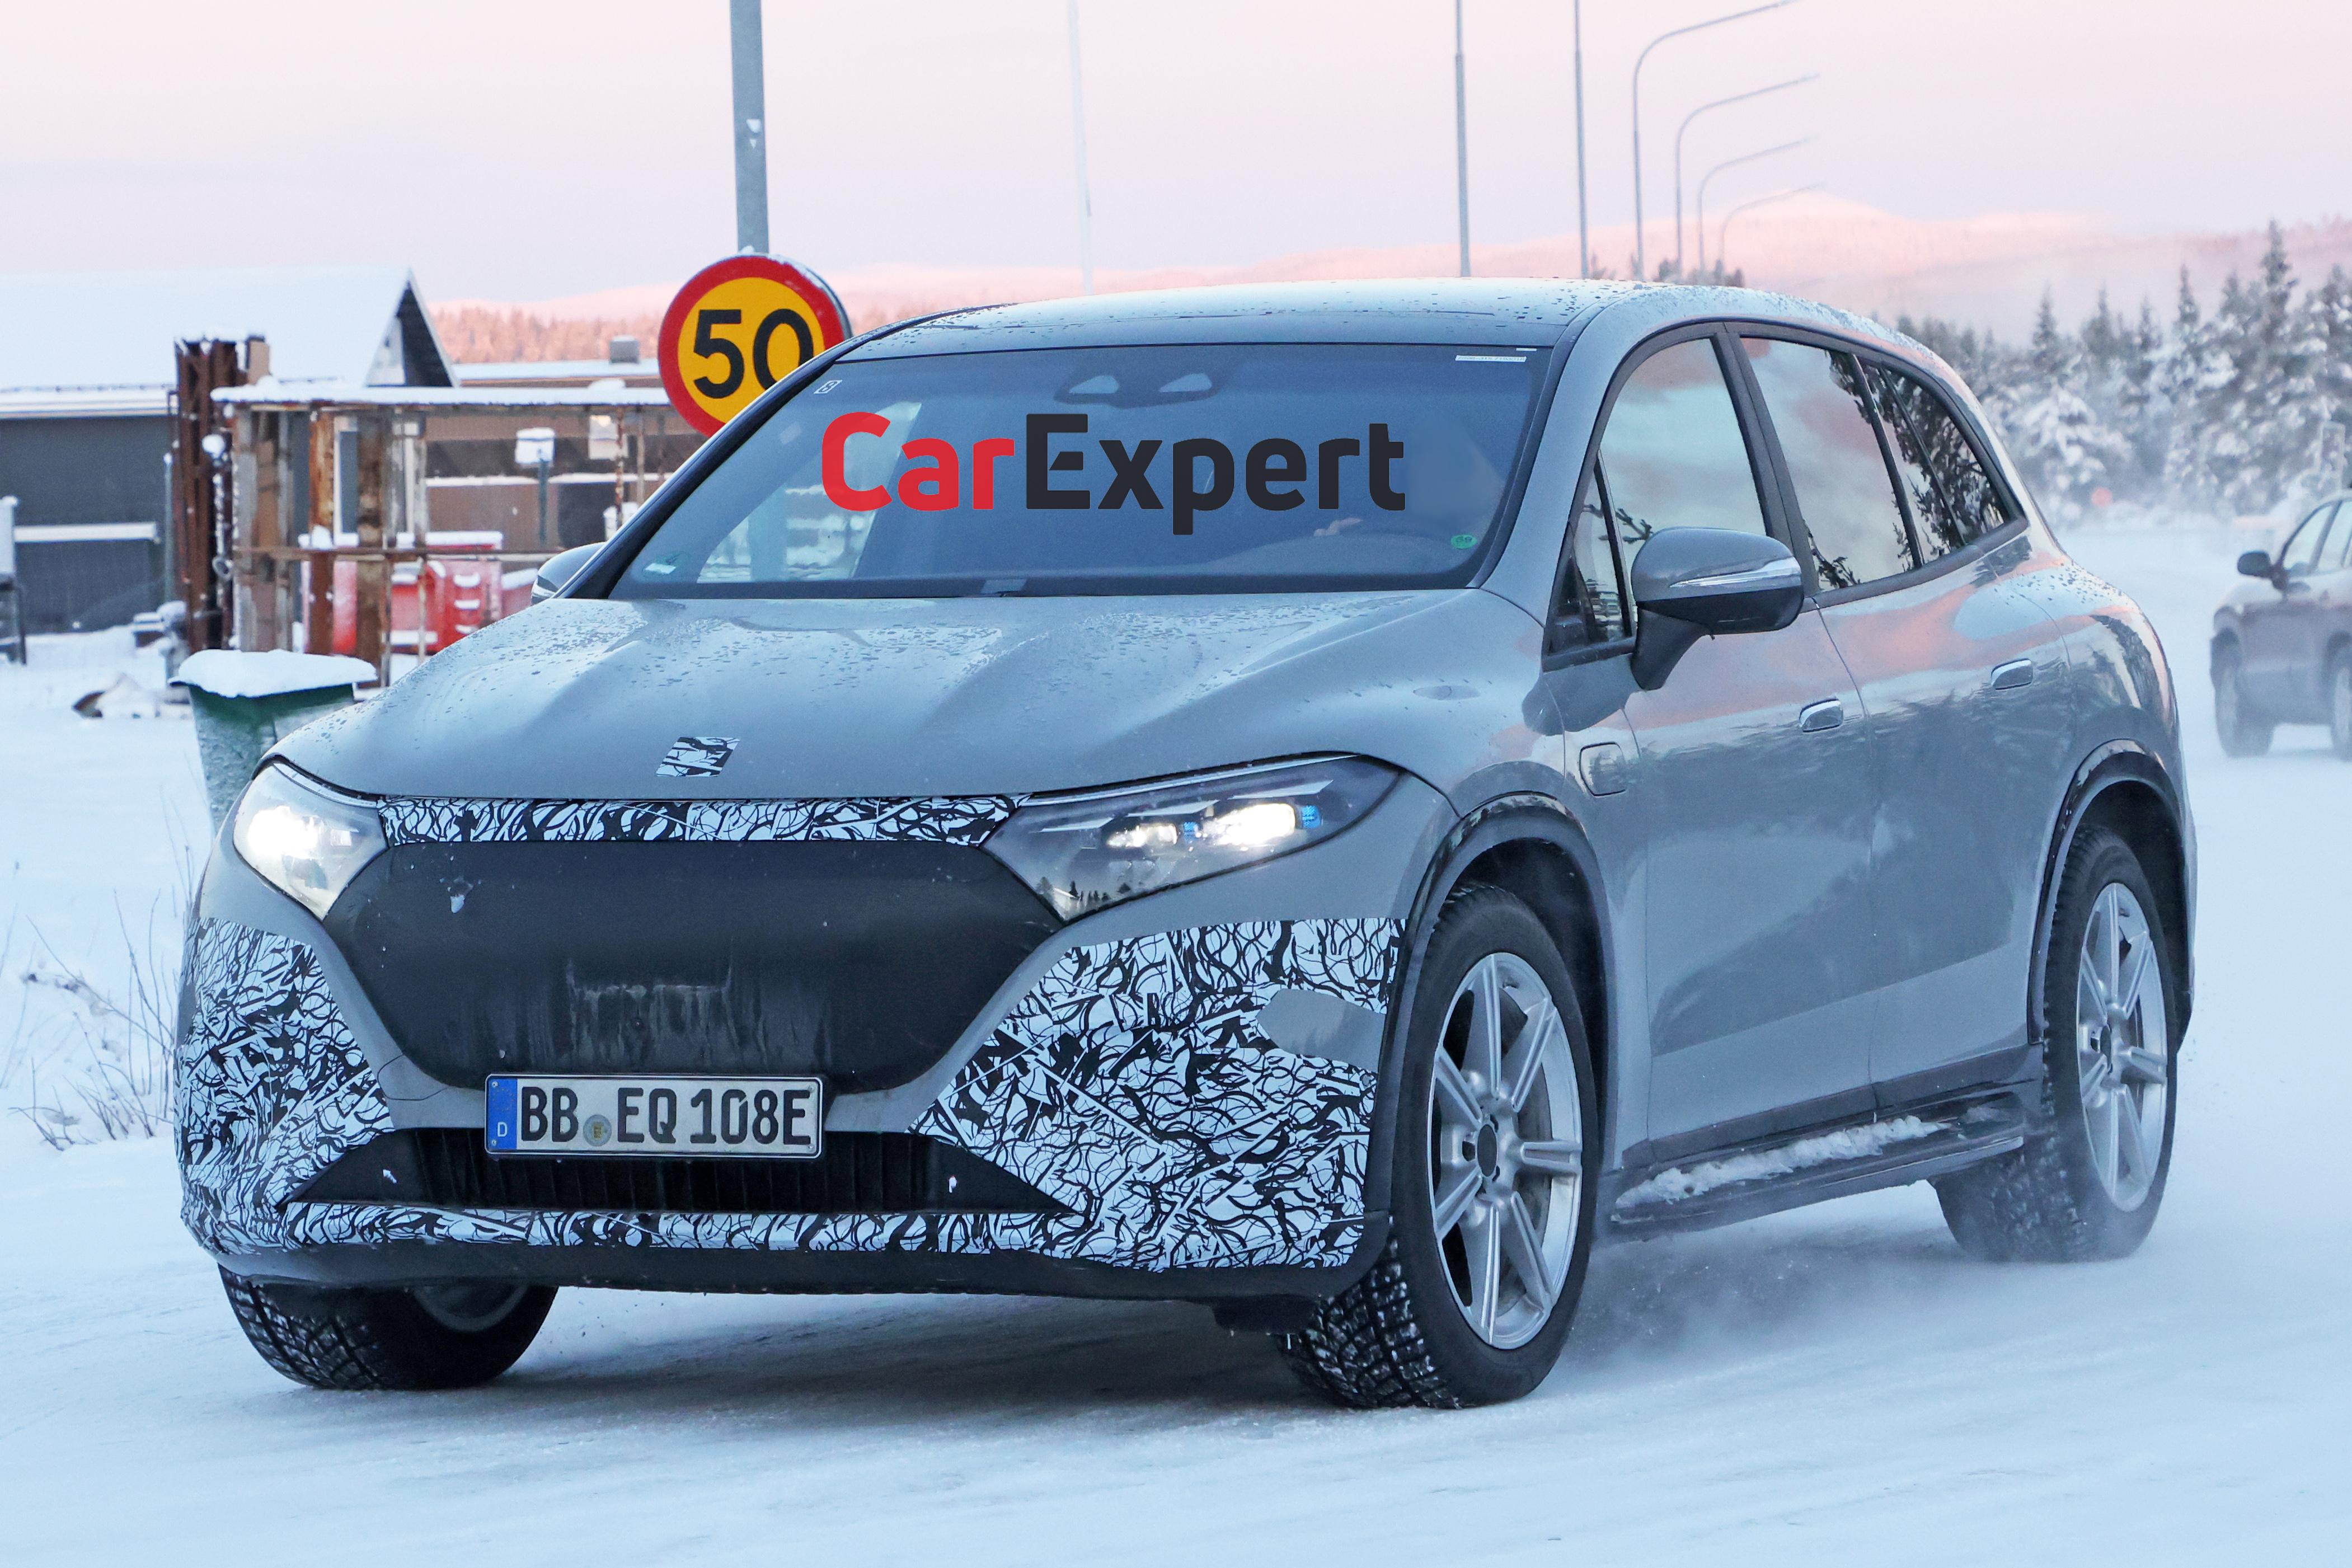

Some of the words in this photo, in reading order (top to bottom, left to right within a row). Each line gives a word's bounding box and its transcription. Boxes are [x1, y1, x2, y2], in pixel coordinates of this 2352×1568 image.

[693, 308, 814, 399] 50
[497, 1121, 508, 1138] D
[521, 1086, 579, 1143] BB
[617, 1087, 677, 1144] EQ
[690, 1088, 811, 1145] 108E
